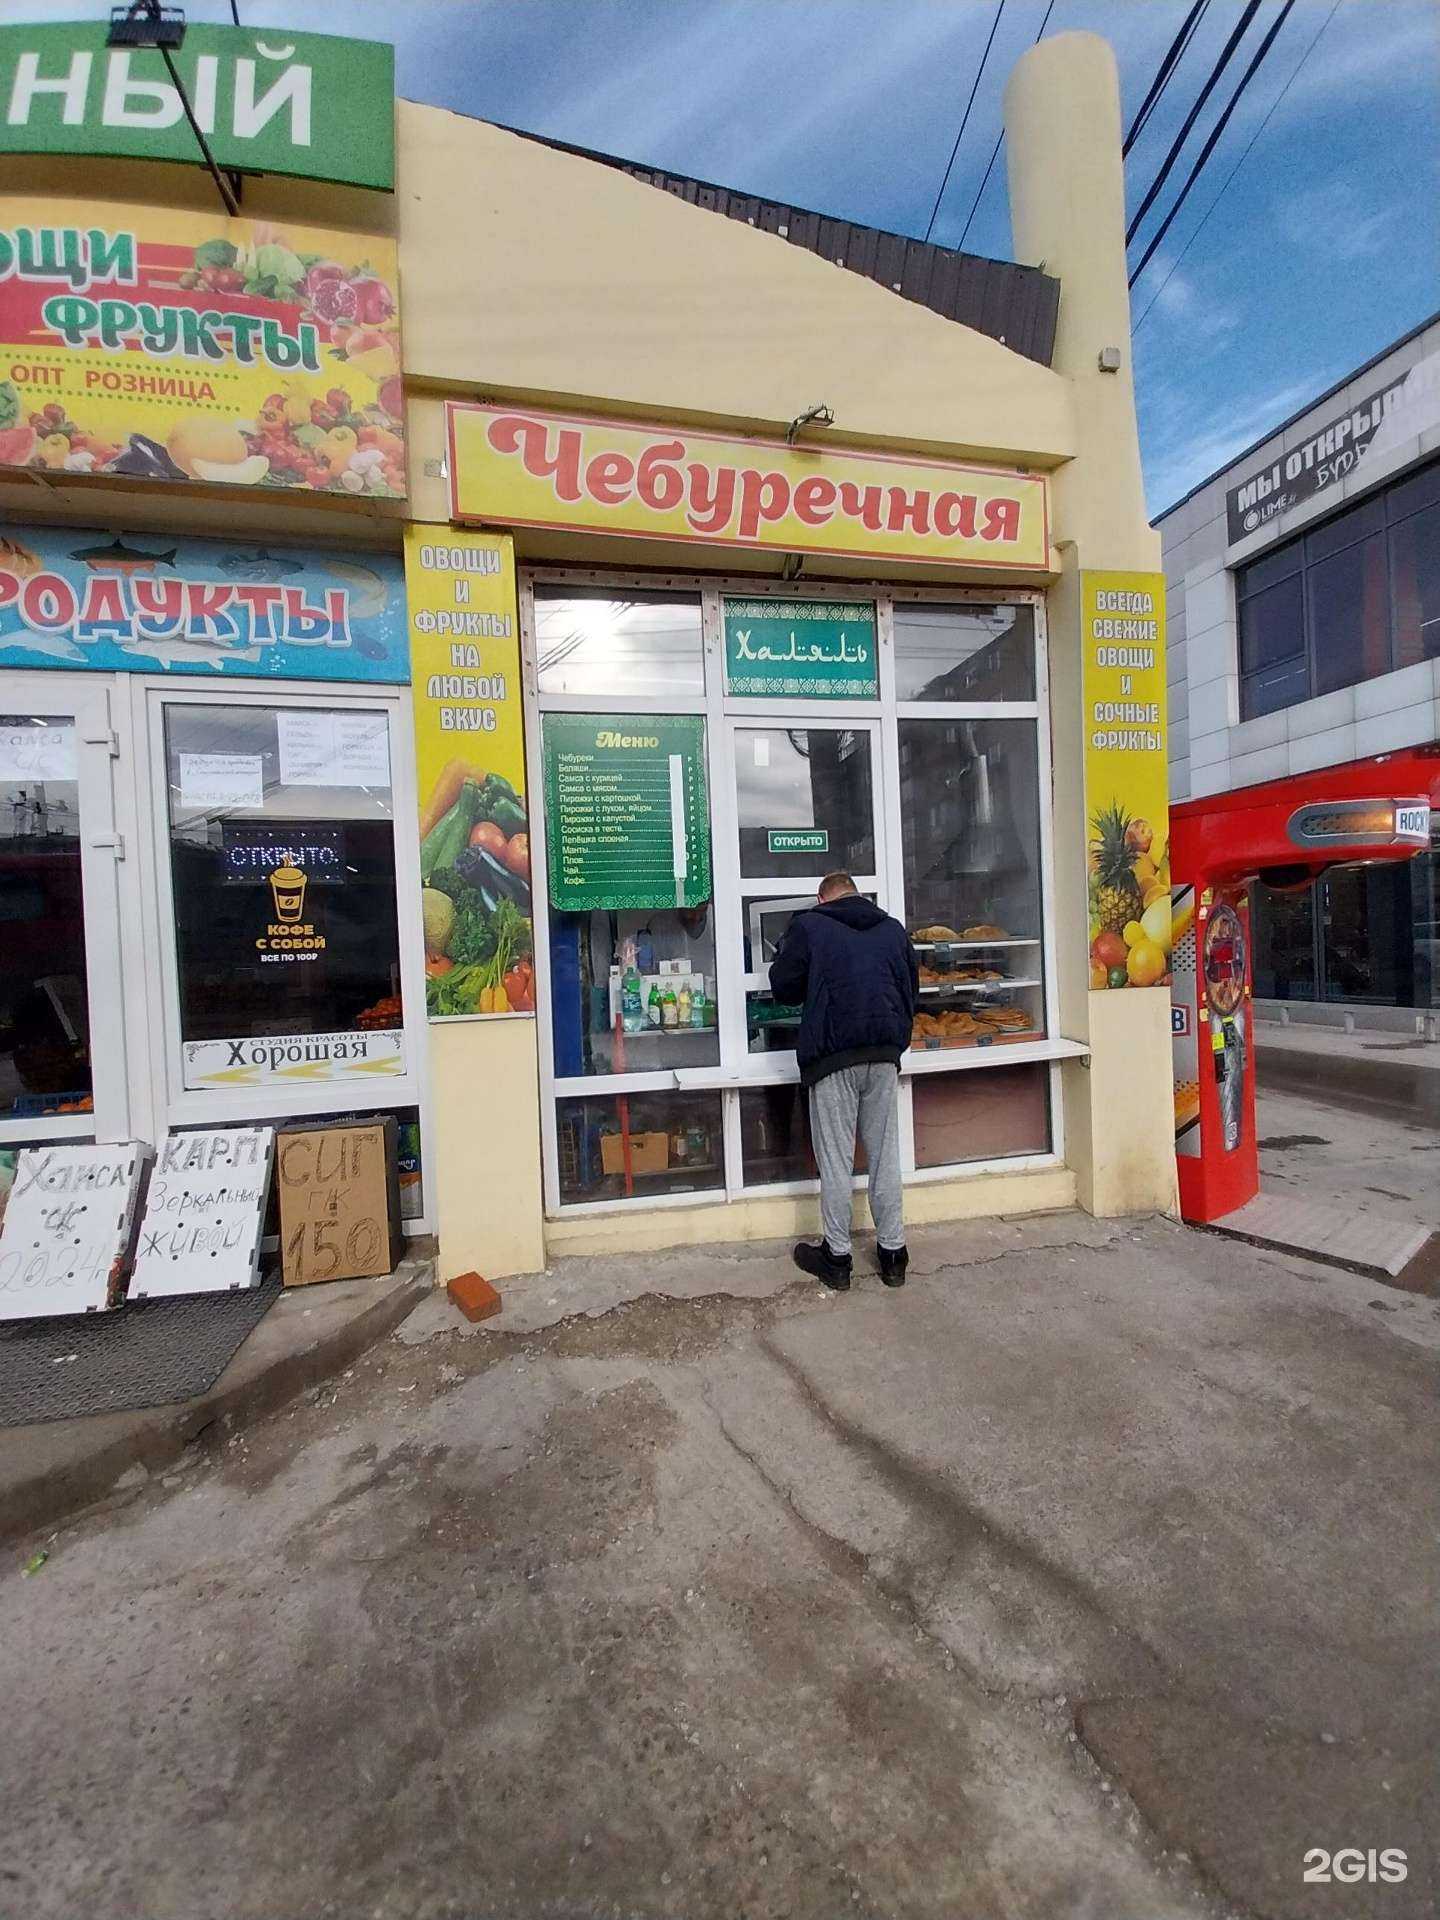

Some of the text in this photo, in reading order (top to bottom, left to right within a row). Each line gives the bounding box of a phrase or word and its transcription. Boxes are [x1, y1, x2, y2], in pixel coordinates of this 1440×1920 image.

[7, 41, 313, 147] НЫЙ
[43, 296, 321, 372] ФРУКТЫ
[10, 364, 216, 401] ОПТ РОЗНИЦА
[487, 416, 1021, 542] Чебуречная
[1238, 463, 1281, 513] МЫ
[420, 544, 500, 576] ОВОЩИ
[455, 579, 470, 603] И
[1096, 590, 1153, 614] ВСЕГДА
[414, 609, 512, 637] ФРУКТЫ
[1093, 618, 1157, 640] СВЕЖИЕ
[451, 643, 480, 667] НА
[1097, 646, 1154, 670] ОВОЩИ
[427, 673, 506, 700] ЛЮБОЙ
[1121, 675, 1132, 695] И
[440, 706, 497, 731] ВКУС
[1094, 702, 1160, 723] СОЧНЫЕ
[595, 731, 659, 748] Меню
[1092, 730, 1162, 750] ФРУКТЫ
[773, 836, 823, 846] ОТКРЫТО
[267, 924, 314, 935] КОФЕ
[255, 936, 326, 949] С СОБОЙ
[250, 1034, 368, 1047] СТУДИЯ КРАСОТЫ
[226, 1041, 367, 1071] Хорошая
[159, 1136, 257, 1175] КАРП
[281, 1134, 377, 1187] СИГ
[287, 1217, 382, 1281] 150
